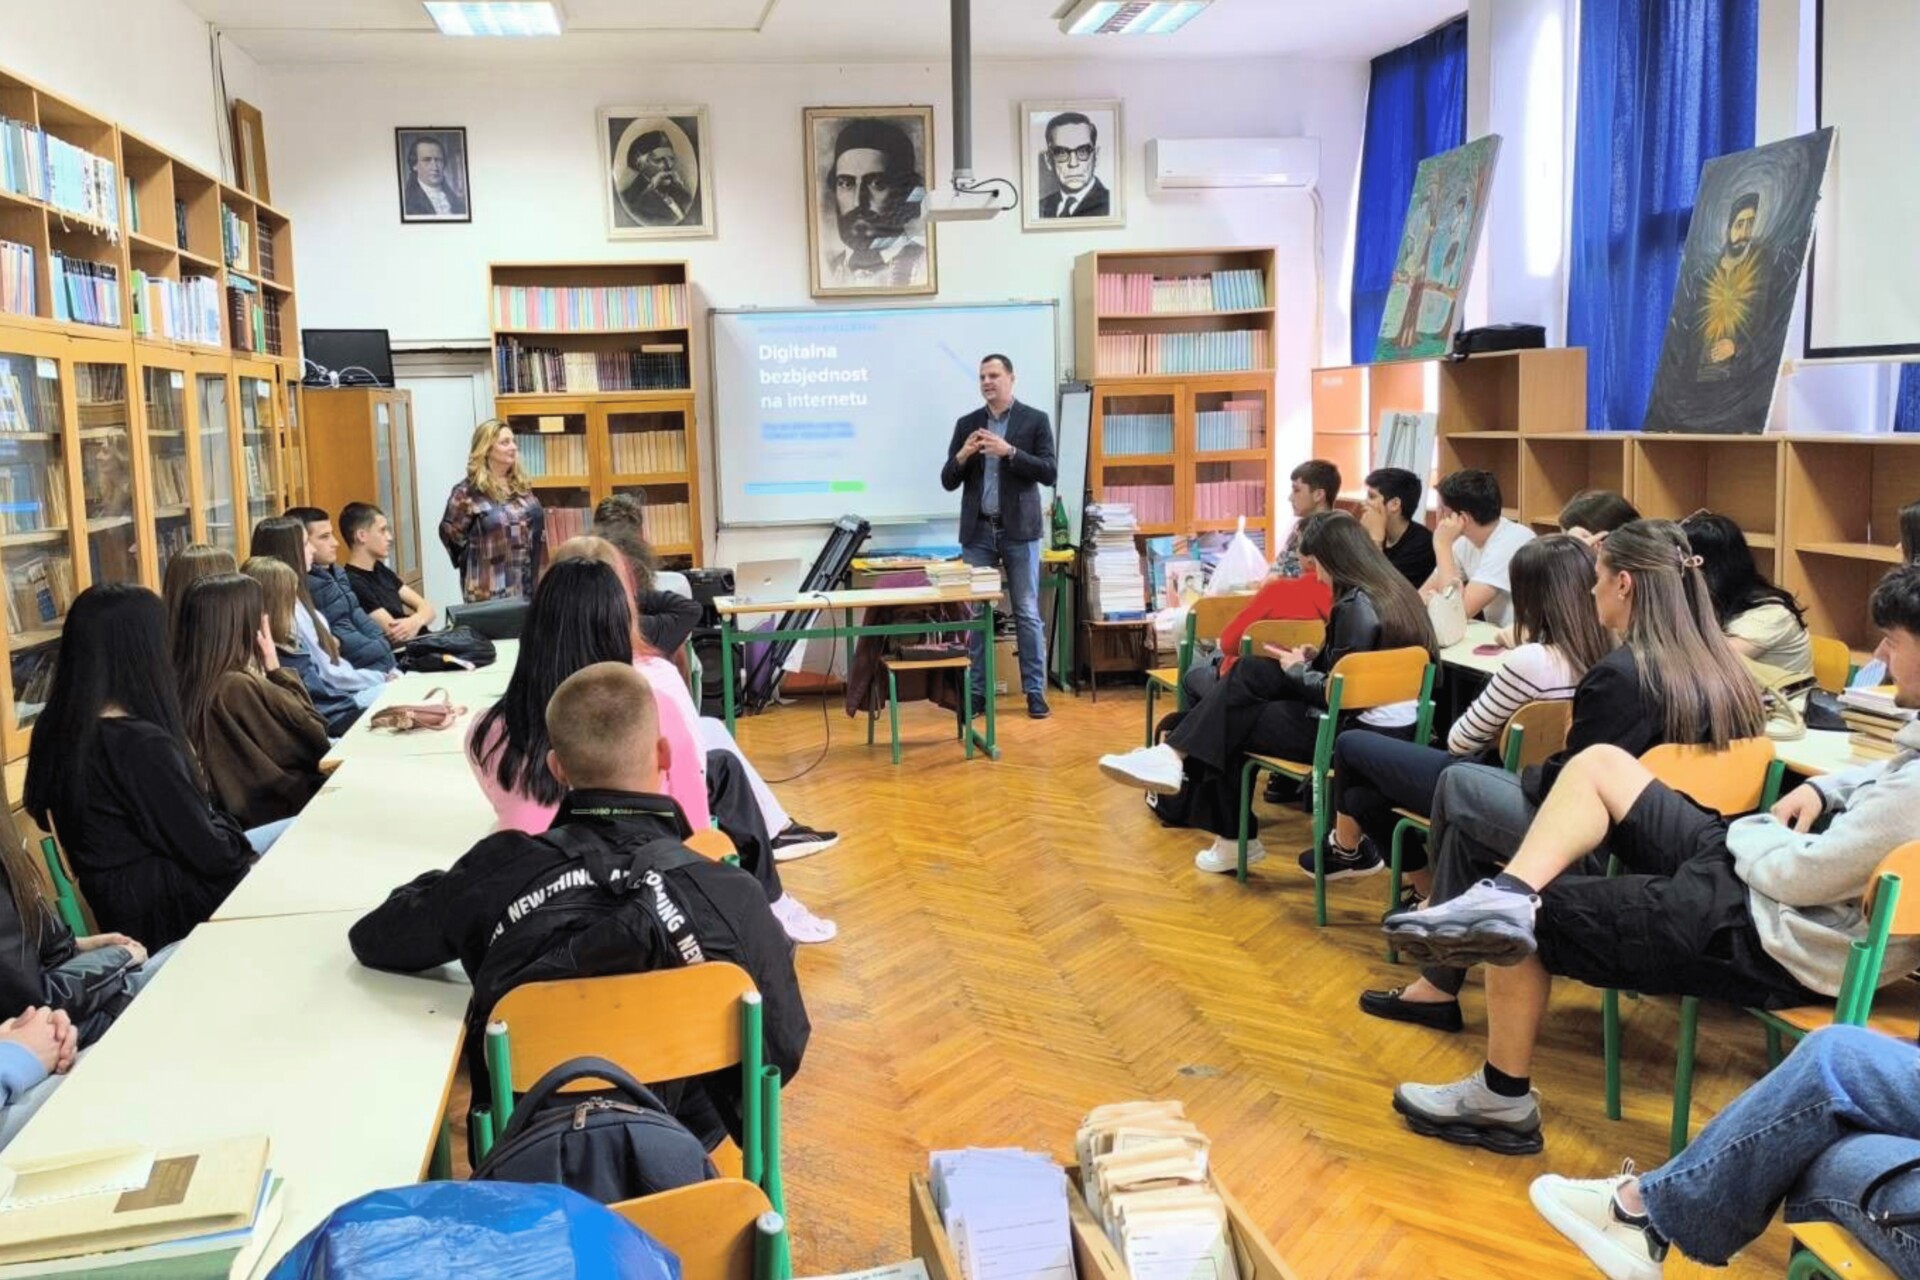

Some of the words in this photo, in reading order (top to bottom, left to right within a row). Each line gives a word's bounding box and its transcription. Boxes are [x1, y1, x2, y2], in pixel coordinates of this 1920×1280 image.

[759, 343, 838, 364] Digitalna
[759, 366, 869, 387] bezbjednost
[761, 395, 783, 408] na
[787, 391, 868, 408] internetu
[507, 888, 545, 923] NEW
